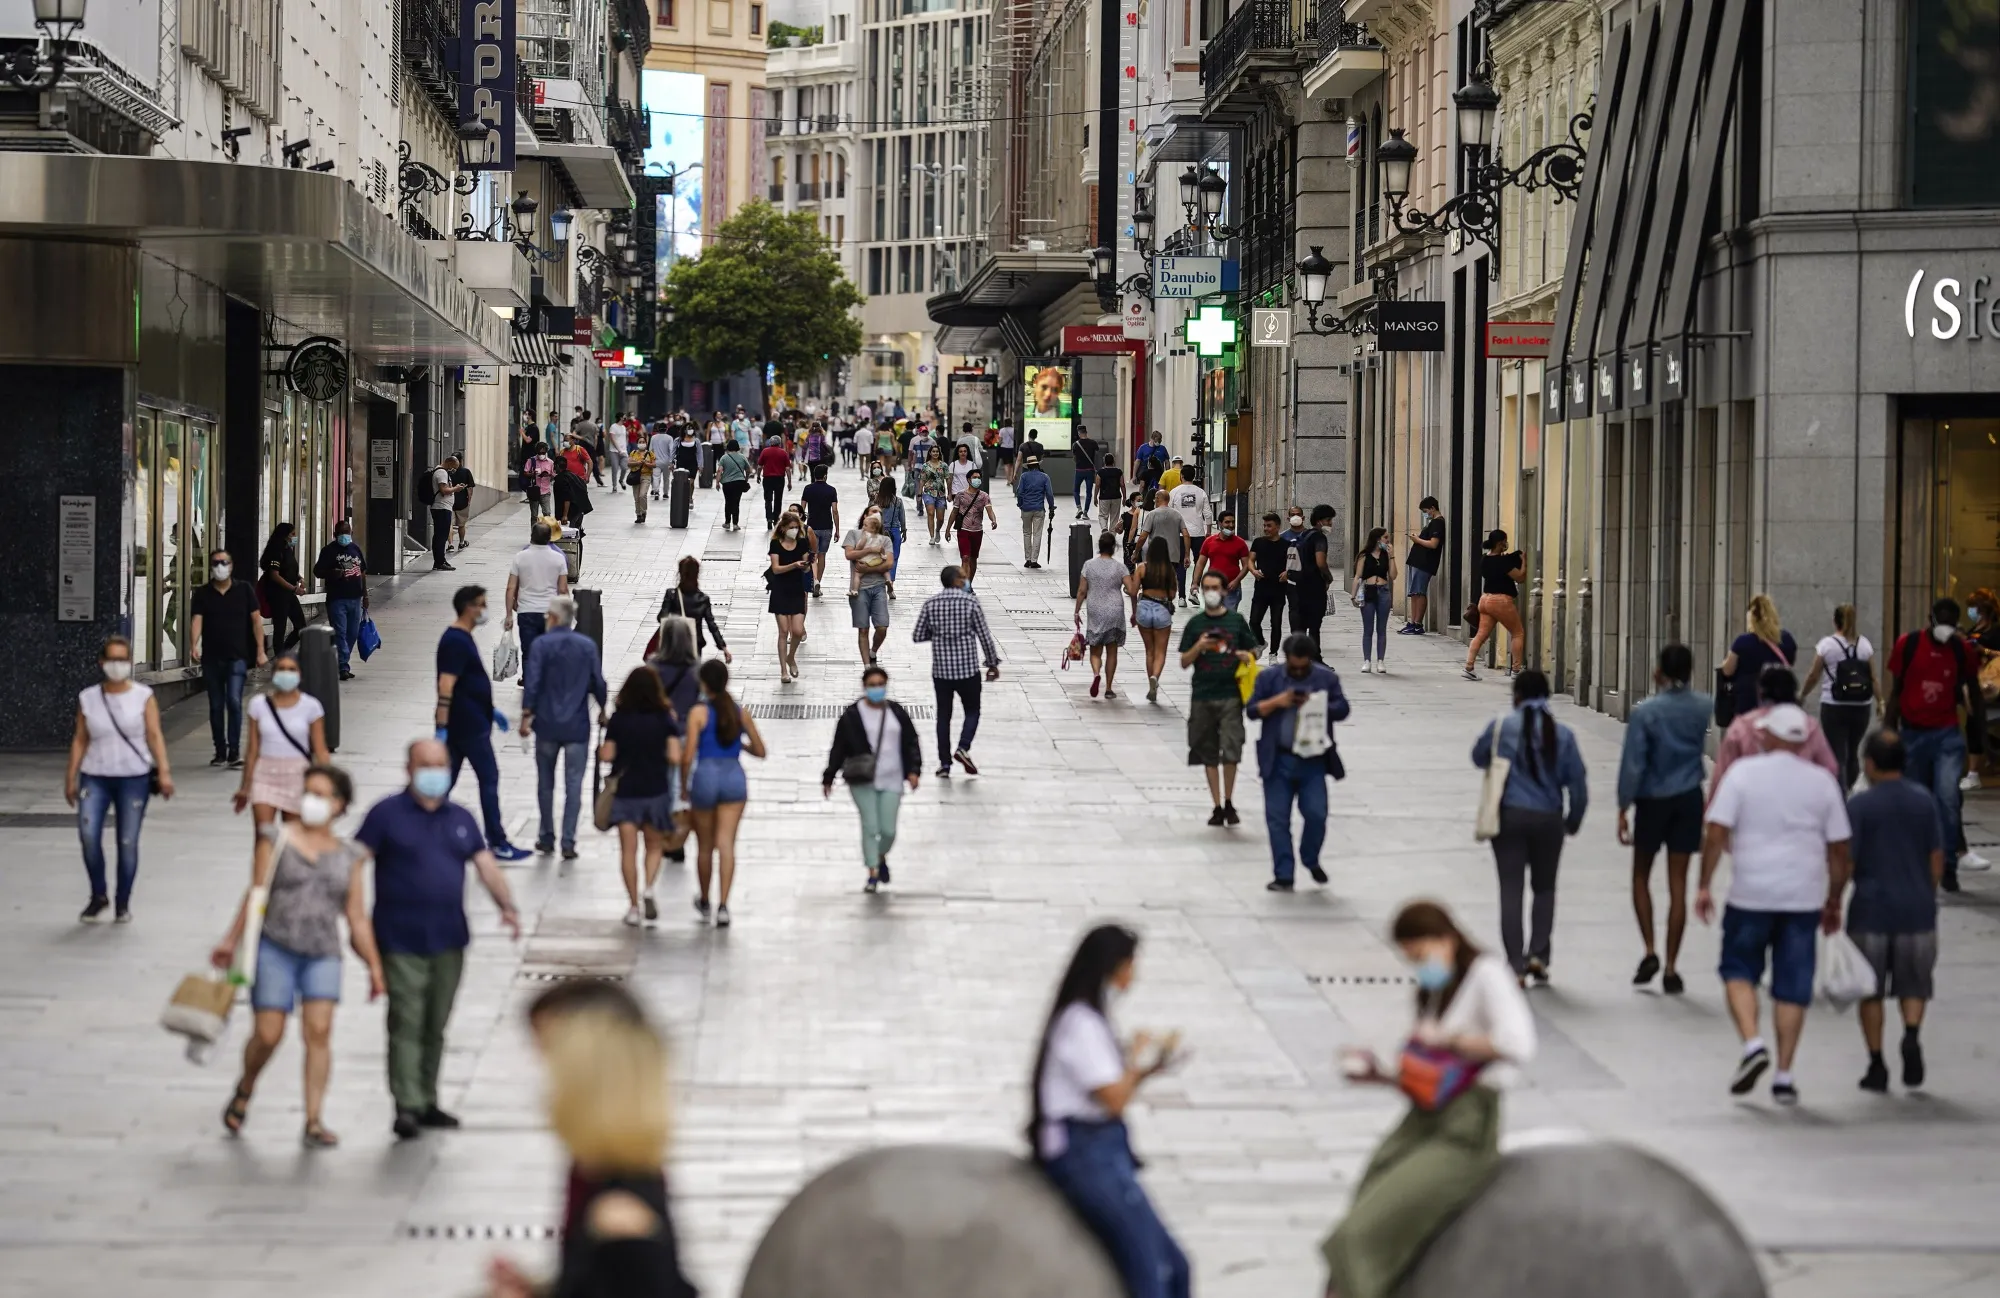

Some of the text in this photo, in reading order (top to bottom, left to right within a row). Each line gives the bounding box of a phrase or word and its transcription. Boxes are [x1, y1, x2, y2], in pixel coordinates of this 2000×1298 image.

[1126, 13, 1137, 25] 15
[1125, 65, 1136, 78] 10
[1128, 118, 1135, 132] 5
[1127, 172, 1134, 185] 0
[1160, 259, 1175, 270] El
[1160, 271, 1216, 283] Danubio
[1160, 284, 1192, 296] Azul
[1384, 321, 1439, 331] MANGO
[1492, 336, 1550, 345] Foot Locker
[521, 365, 548, 376] REYES
